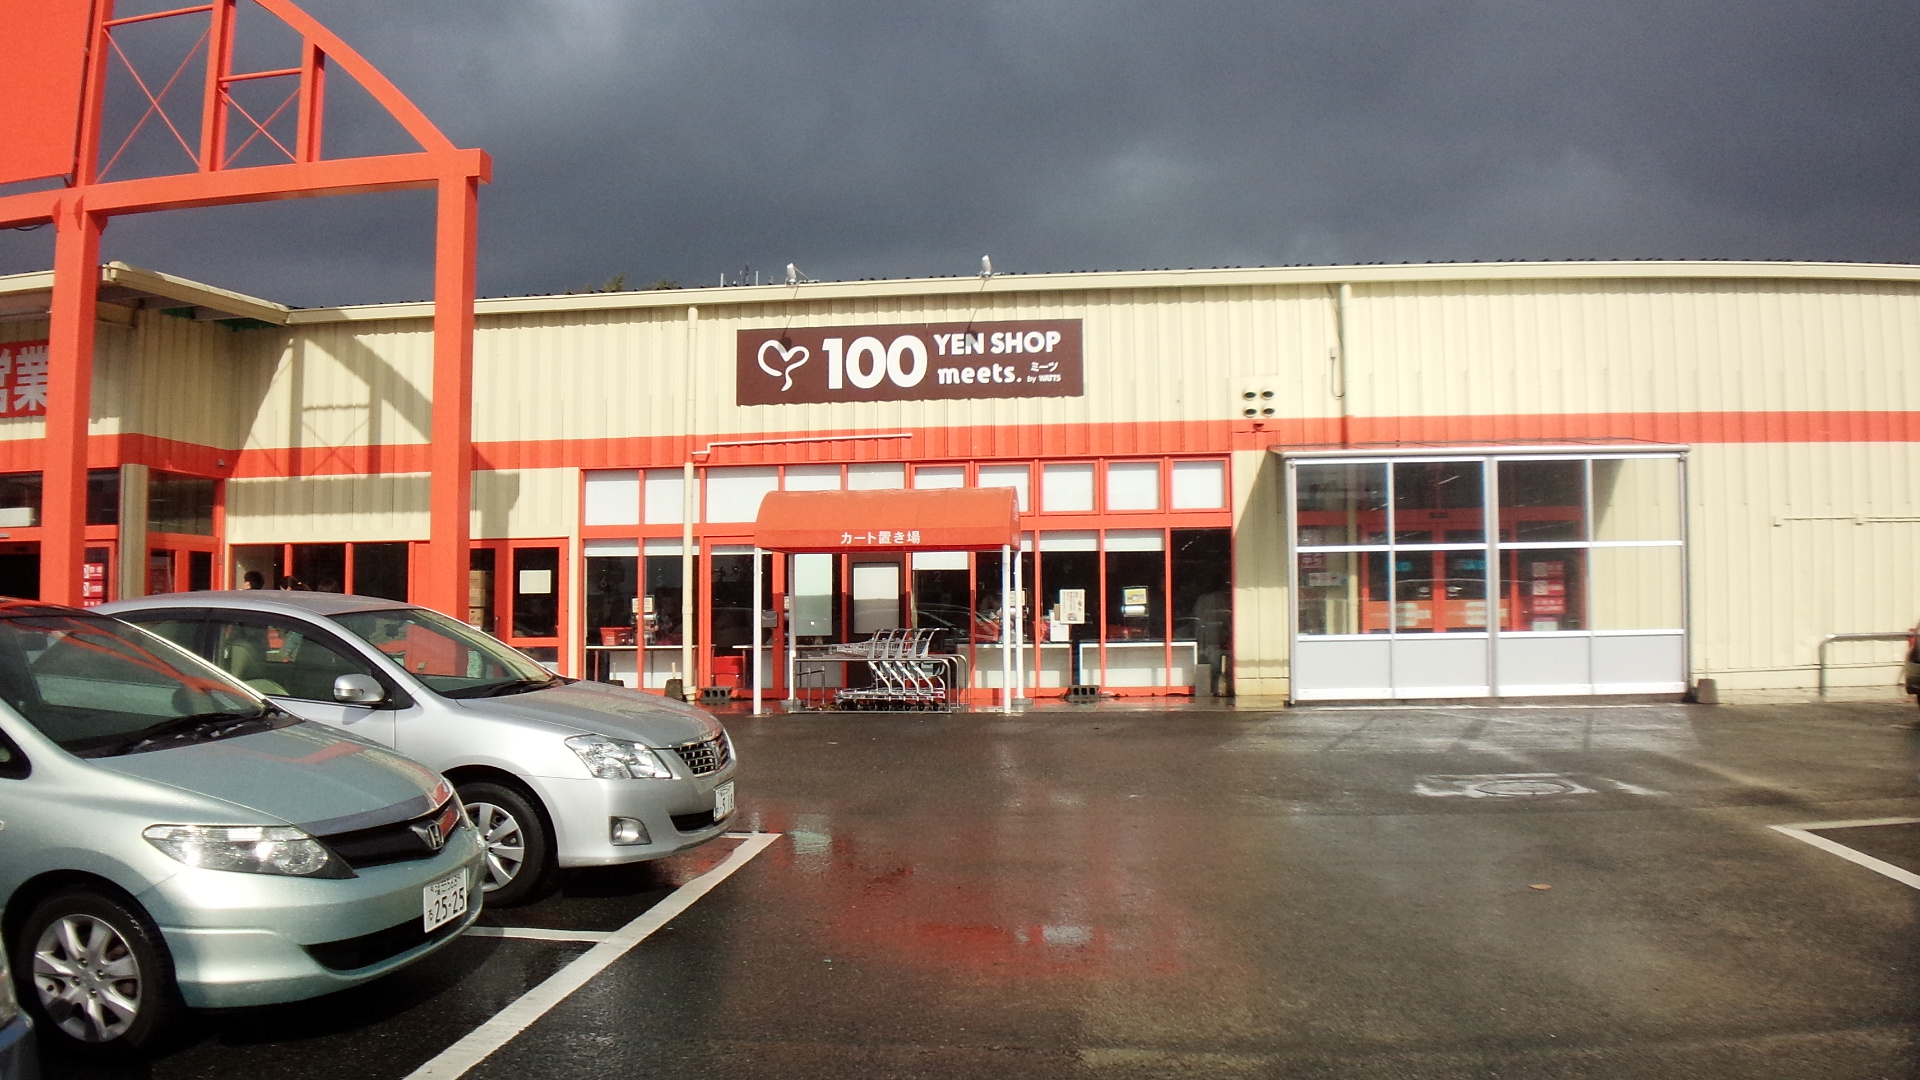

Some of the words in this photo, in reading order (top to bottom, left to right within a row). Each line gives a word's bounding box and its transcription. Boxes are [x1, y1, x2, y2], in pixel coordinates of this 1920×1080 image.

[933, 332, 985, 356] YEN
[990, 331, 1061, 354] SHOP
[822, 335, 928, 390] 100
[1031, 362, 1059, 373] ミーツ
[937, 363, 1022, 385] meets.
[1027, 375, 1037, 383] by
[840, 531, 921, 545] カート置き場
[434, 886, 465, 924] 25-25
